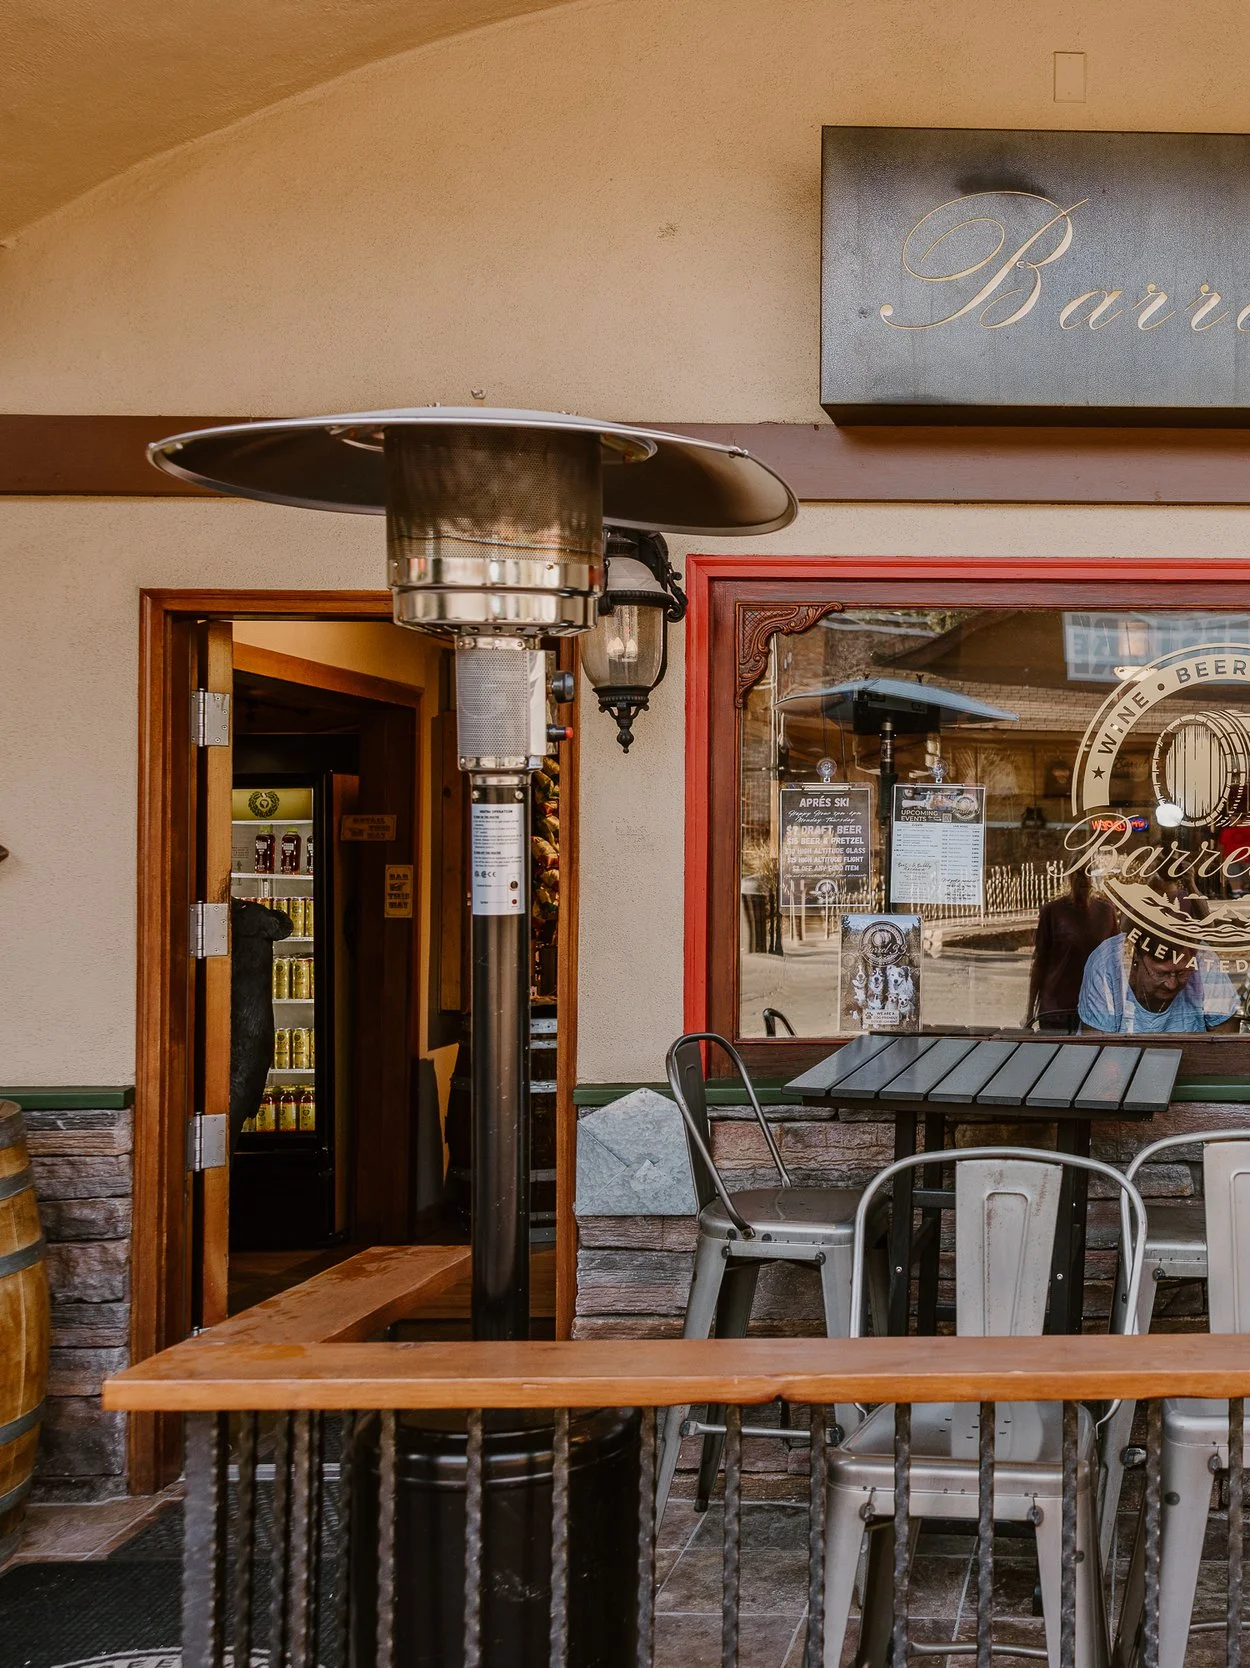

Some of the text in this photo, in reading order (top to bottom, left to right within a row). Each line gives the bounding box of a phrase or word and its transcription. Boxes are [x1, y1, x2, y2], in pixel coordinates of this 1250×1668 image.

[1097, 690, 1150, 756] WINE
[1174, 659, 1248, 684] BEER
[834, 798, 850, 807] SKI
[801, 825, 834, 836] DRAFT
[836, 825, 862, 835] BEER
[800, 836, 820, 845] BEER
[831, 836, 865, 845] PRETZEL
[1126, 927, 1249, 973] ELEVATED
